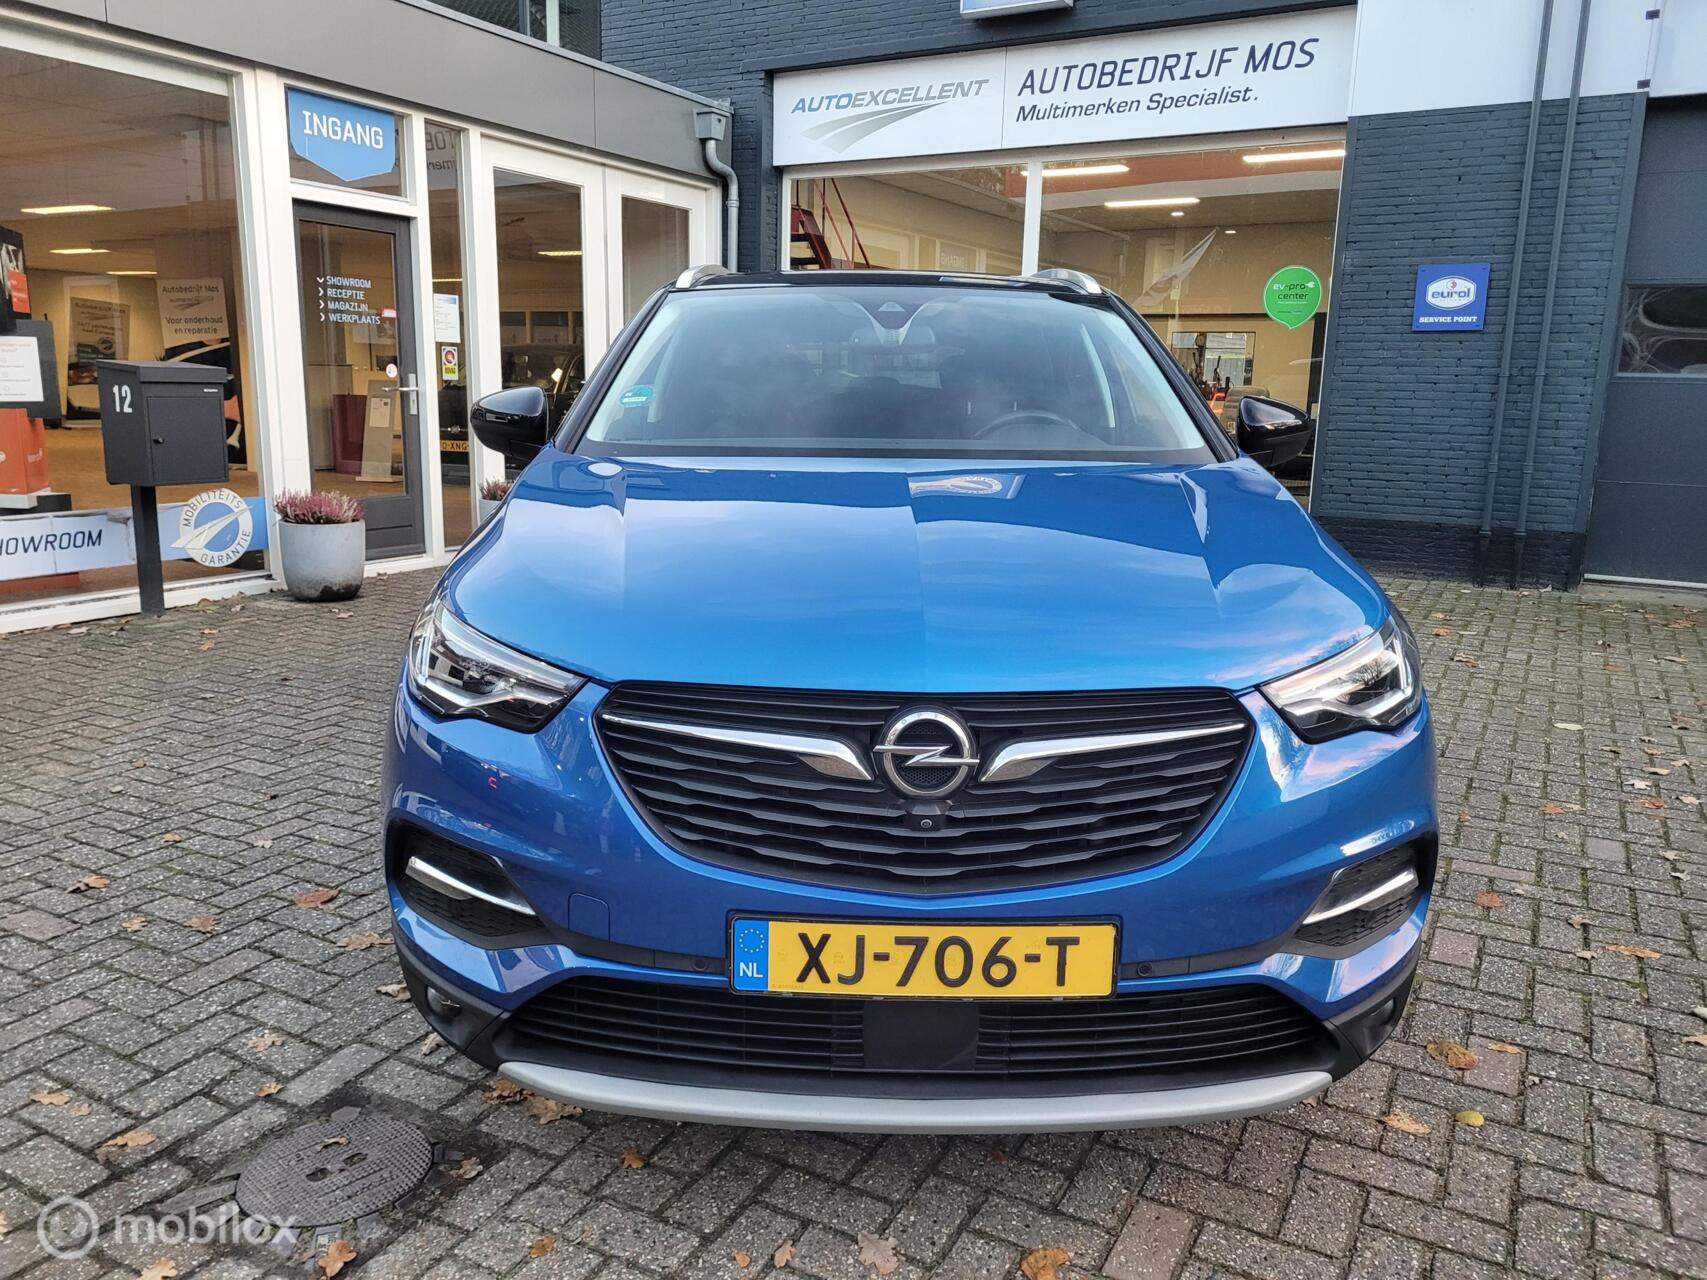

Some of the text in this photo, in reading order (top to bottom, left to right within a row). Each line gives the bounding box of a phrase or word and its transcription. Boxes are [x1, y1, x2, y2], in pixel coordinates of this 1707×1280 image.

[1017, 37, 1320, 97] AUTOBEDRIJF MOS
[790, 79, 990, 115] AUTOEXCELLENT
[1015, 85, 1259, 123] Multimerken Specialist.
[302, 109, 385, 150] INGANG
[326, 275, 372, 289] SHOWROOM
[326, 288, 366, 300] RECEPTIE
[1431, 288, 1471, 298] eurol
[327, 300, 369, 312] MAGAZIJN
[328, 312, 381, 325] WERKPLAATS
[1418, 315, 1478, 324] SERVICE POINT
[112, 384, 133, 413] 12
[182, 488, 244, 528] MOBILITEITS
[200, 528, 252, 566] GARANTIE
[739, 931, 1081, 989] NL XJ-706-T
